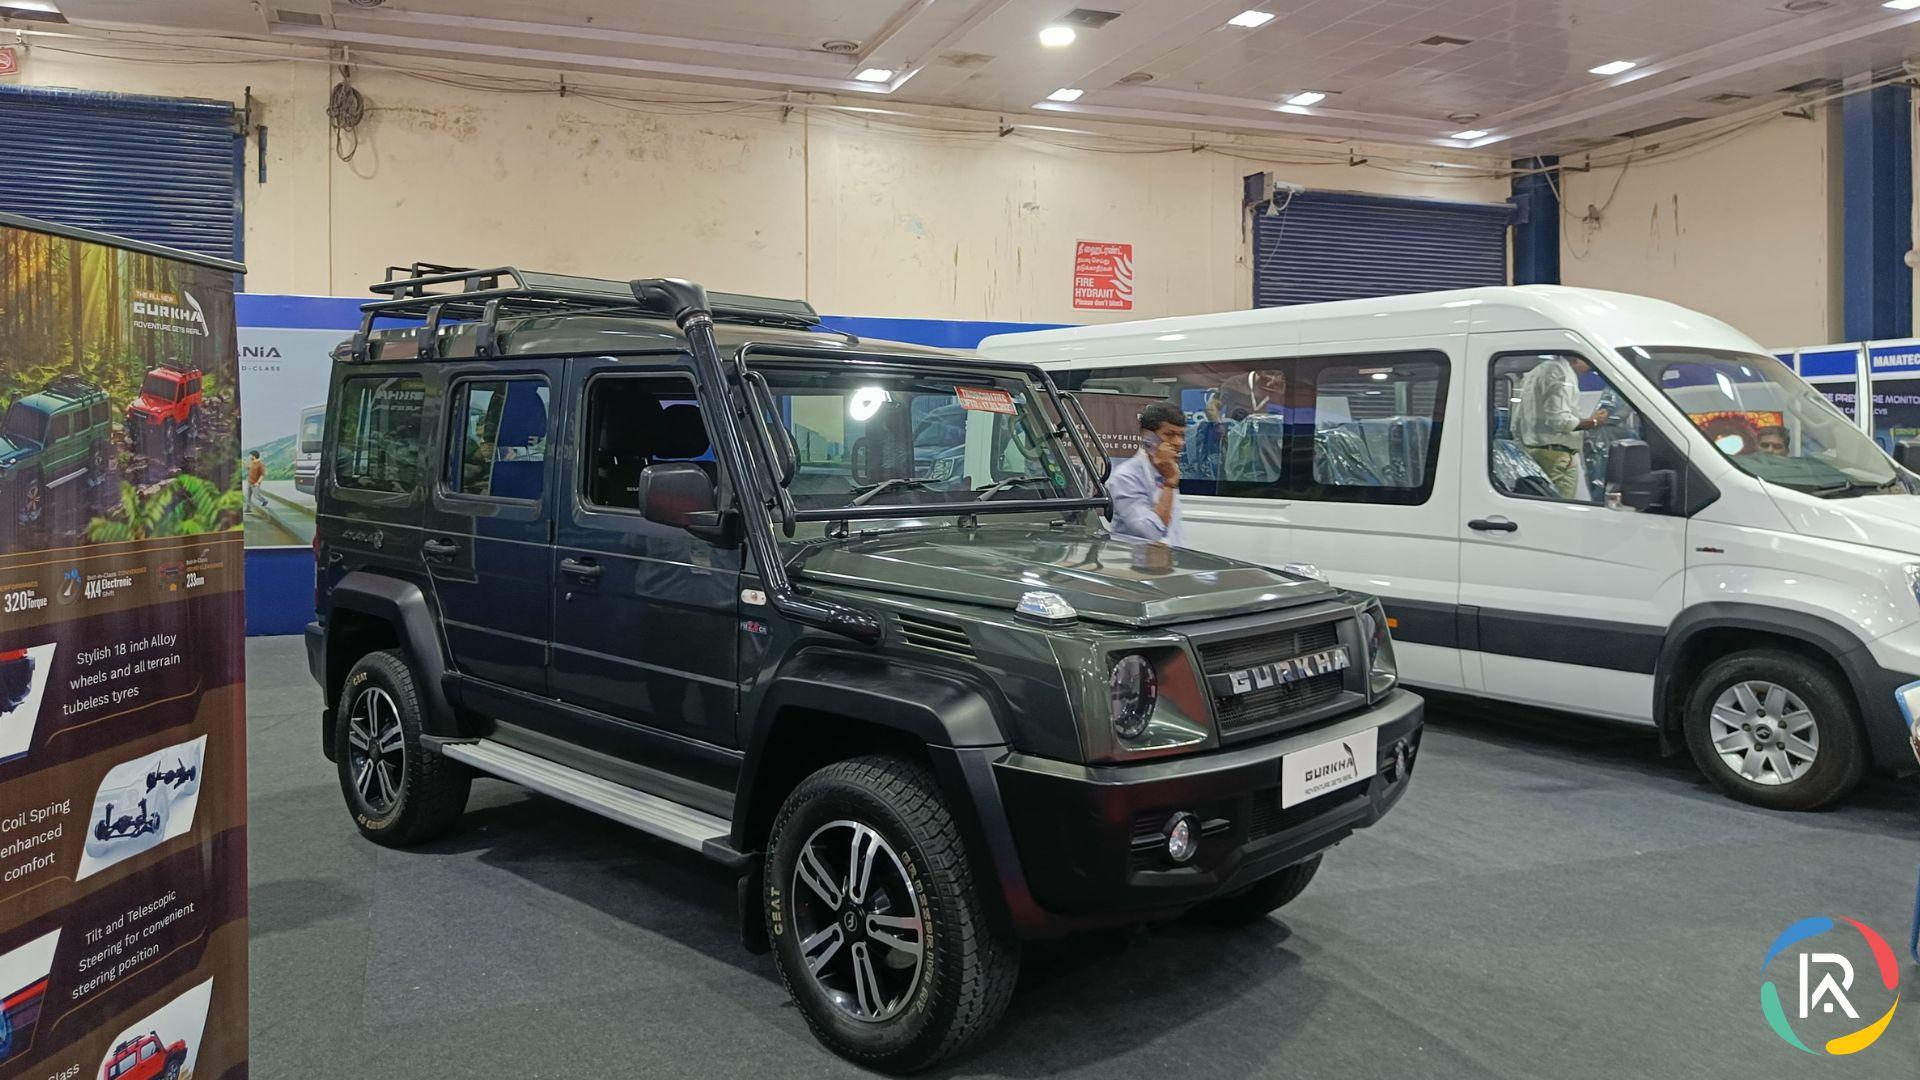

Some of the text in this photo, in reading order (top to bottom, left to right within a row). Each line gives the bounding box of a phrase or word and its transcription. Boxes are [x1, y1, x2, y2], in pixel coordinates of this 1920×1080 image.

[1074, 288, 1115, 298] HYDRANT
[1075, 277, 1095, 287] FIRE
[133, 301, 203, 323] GURKHA
[133, 320, 203, 336] ADVENTURE GETS REAL
[238, 346, 282, 358] NiA
[1873, 353, 1920, 367] MANATEC
[4, 591, 48, 613] 320 Torque
[84, 575, 132, 600] 4X4 Electronic
[76, 633, 177, 666] Stylish 18 inch Alloy
[70, 654, 181, 690] wheels and all terrain
[1229, 646, 1350, 695] GURKHA
[62, 685, 140, 716] tubeless tyres
[1305, 757, 1354, 782] GURKHA
[1, 799, 71, 833] Coil Spring
[0, 824, 63, 859] enhanced
[4, 851, 56, 882] comfort
[85, 889, 177, 946] Tilt and Telescopic
[770, 886, 783, 936] CEAT
[79, 901, 195, 973] Steering for convenient
[72, 942, 159, 1000] steering position
